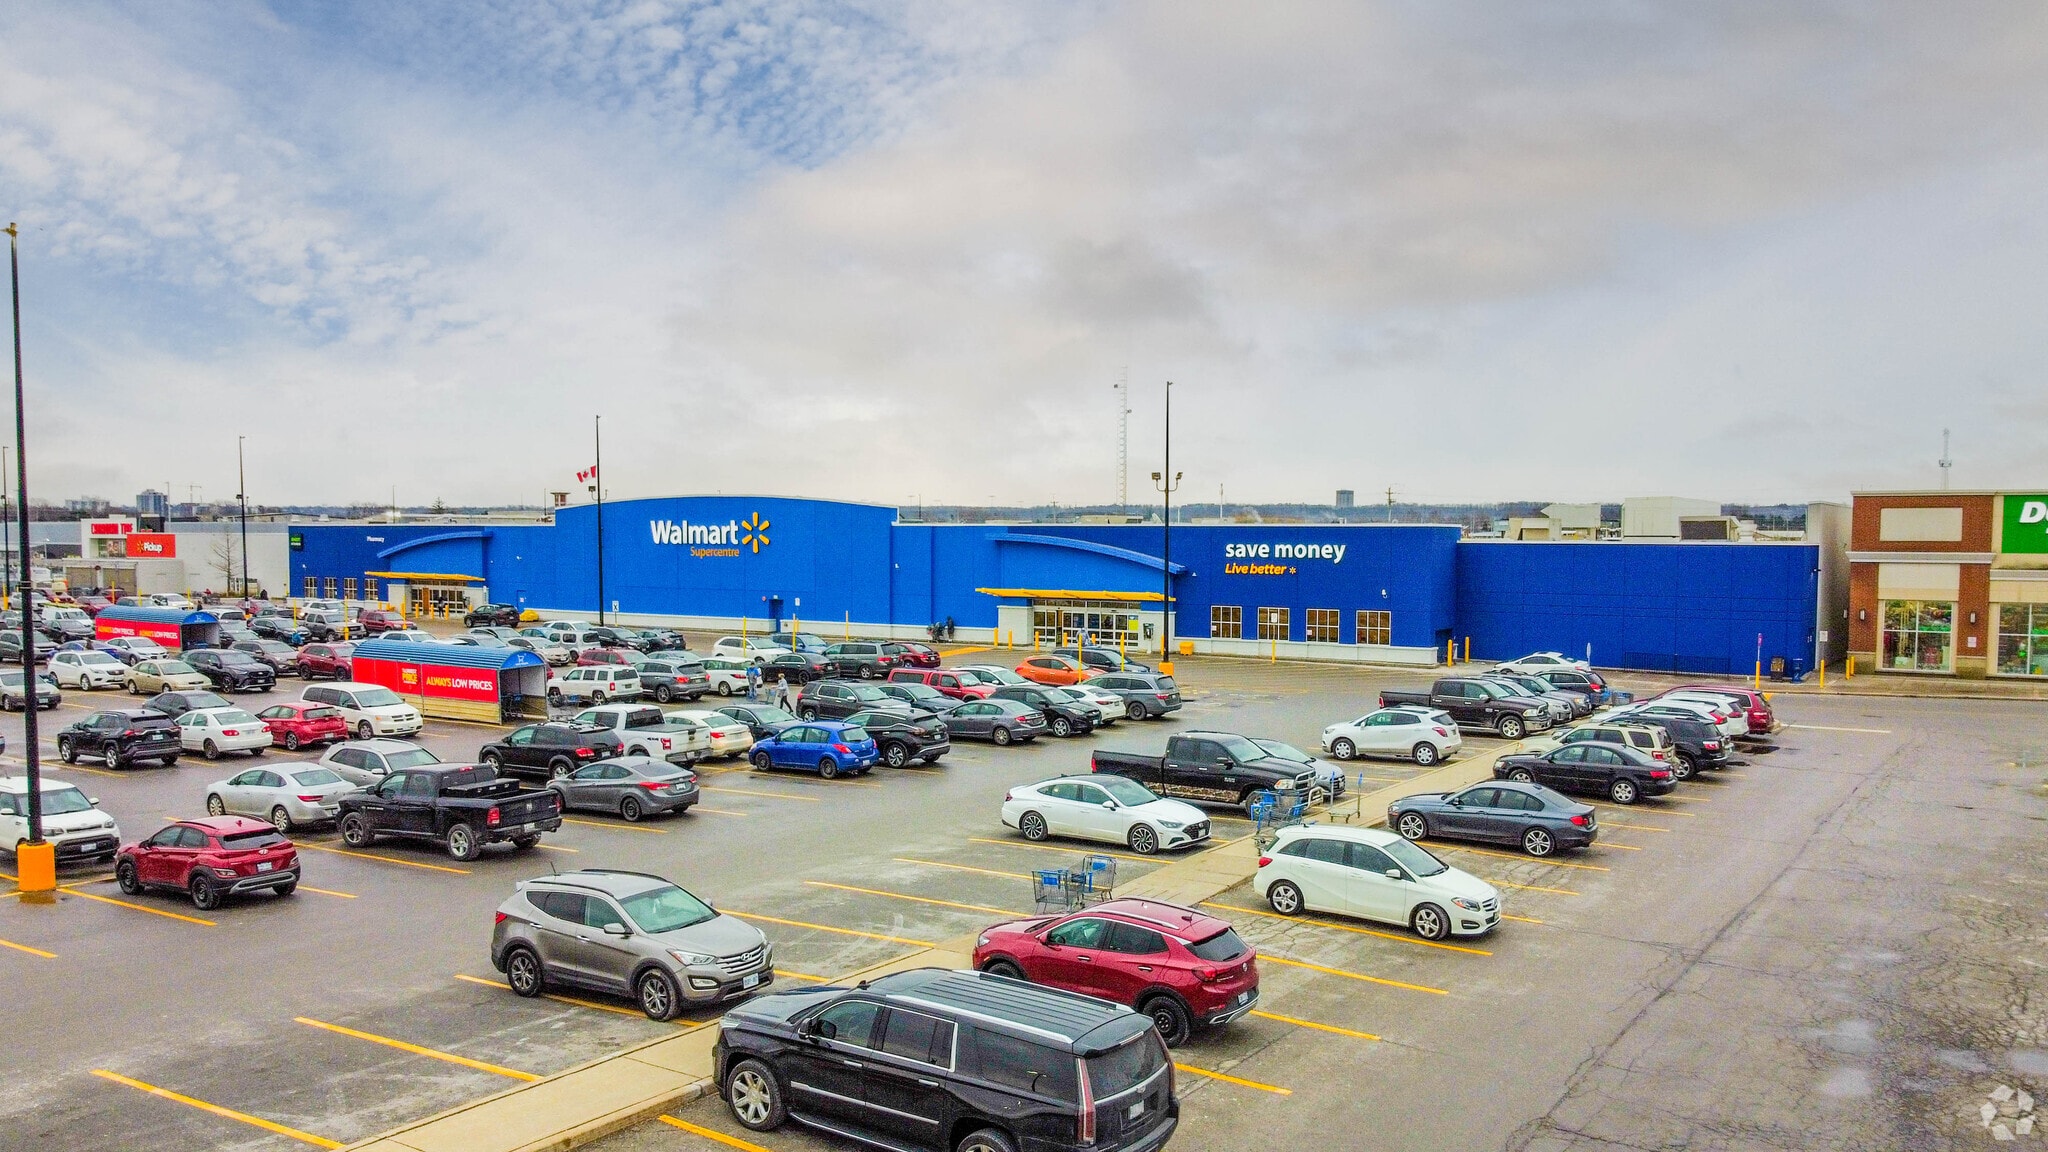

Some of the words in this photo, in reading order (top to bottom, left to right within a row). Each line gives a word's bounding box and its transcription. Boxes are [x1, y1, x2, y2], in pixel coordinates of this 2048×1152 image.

[2019, 501, 2048, 523] D
[650, 520, 738, 545] Walmart
[143, 541, 162, 553] Pickup
[690, 546, 739, 559] Supercentre
[1225, 543, 1270, 558] save
[1274, 544, 1346, 564] money
[1225, 562, 1249, 574] Live
[1249, 563, 1287, 575] better
[426, 676, 451, 687] ALWAYS
[452, 678, 468, 688] LOW
[469, 680, 493, 691] PRICES
